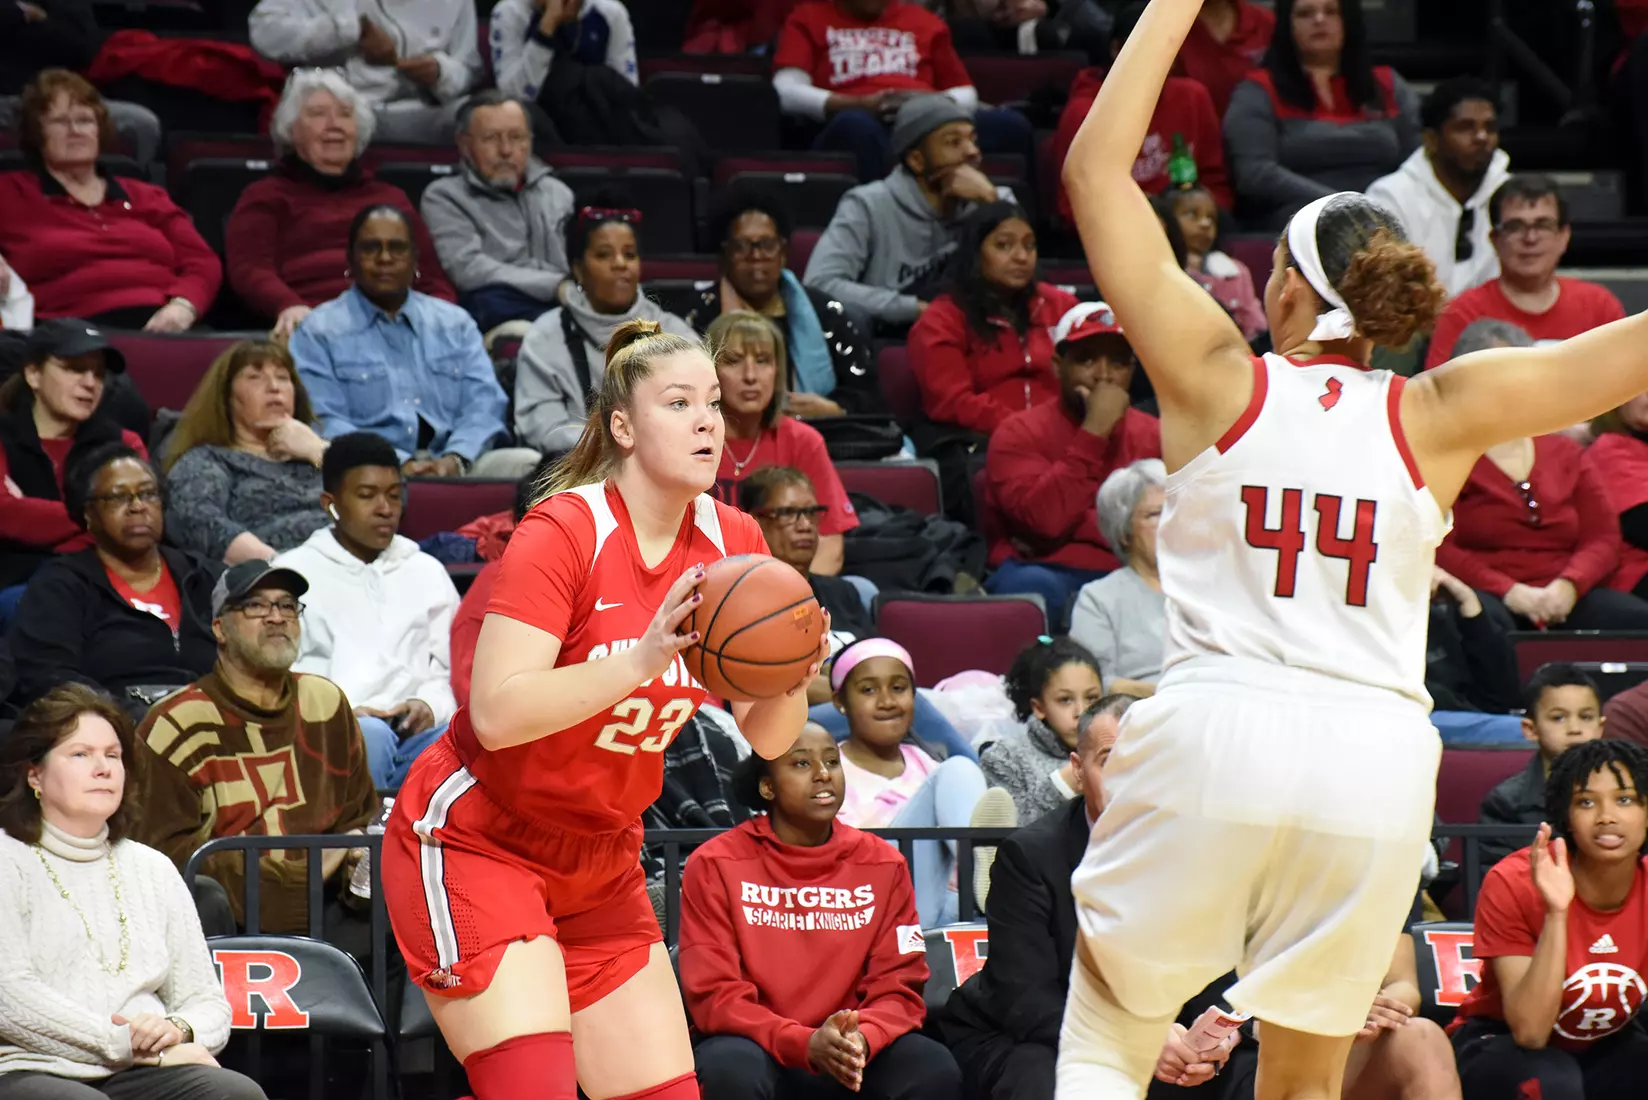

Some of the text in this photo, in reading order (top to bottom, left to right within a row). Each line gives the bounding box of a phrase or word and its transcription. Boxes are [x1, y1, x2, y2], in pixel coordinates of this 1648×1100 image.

[1241, 485, 1378, 607] 44
[593, 697, 694, 756] 23
[741, 881, 875, 908] RUTGERS
[751, 907, 867, 931] SCARLET KNIGHTS
[213, 950, 309, 1029] R
[1576, 1008, 1616, 1030] R
